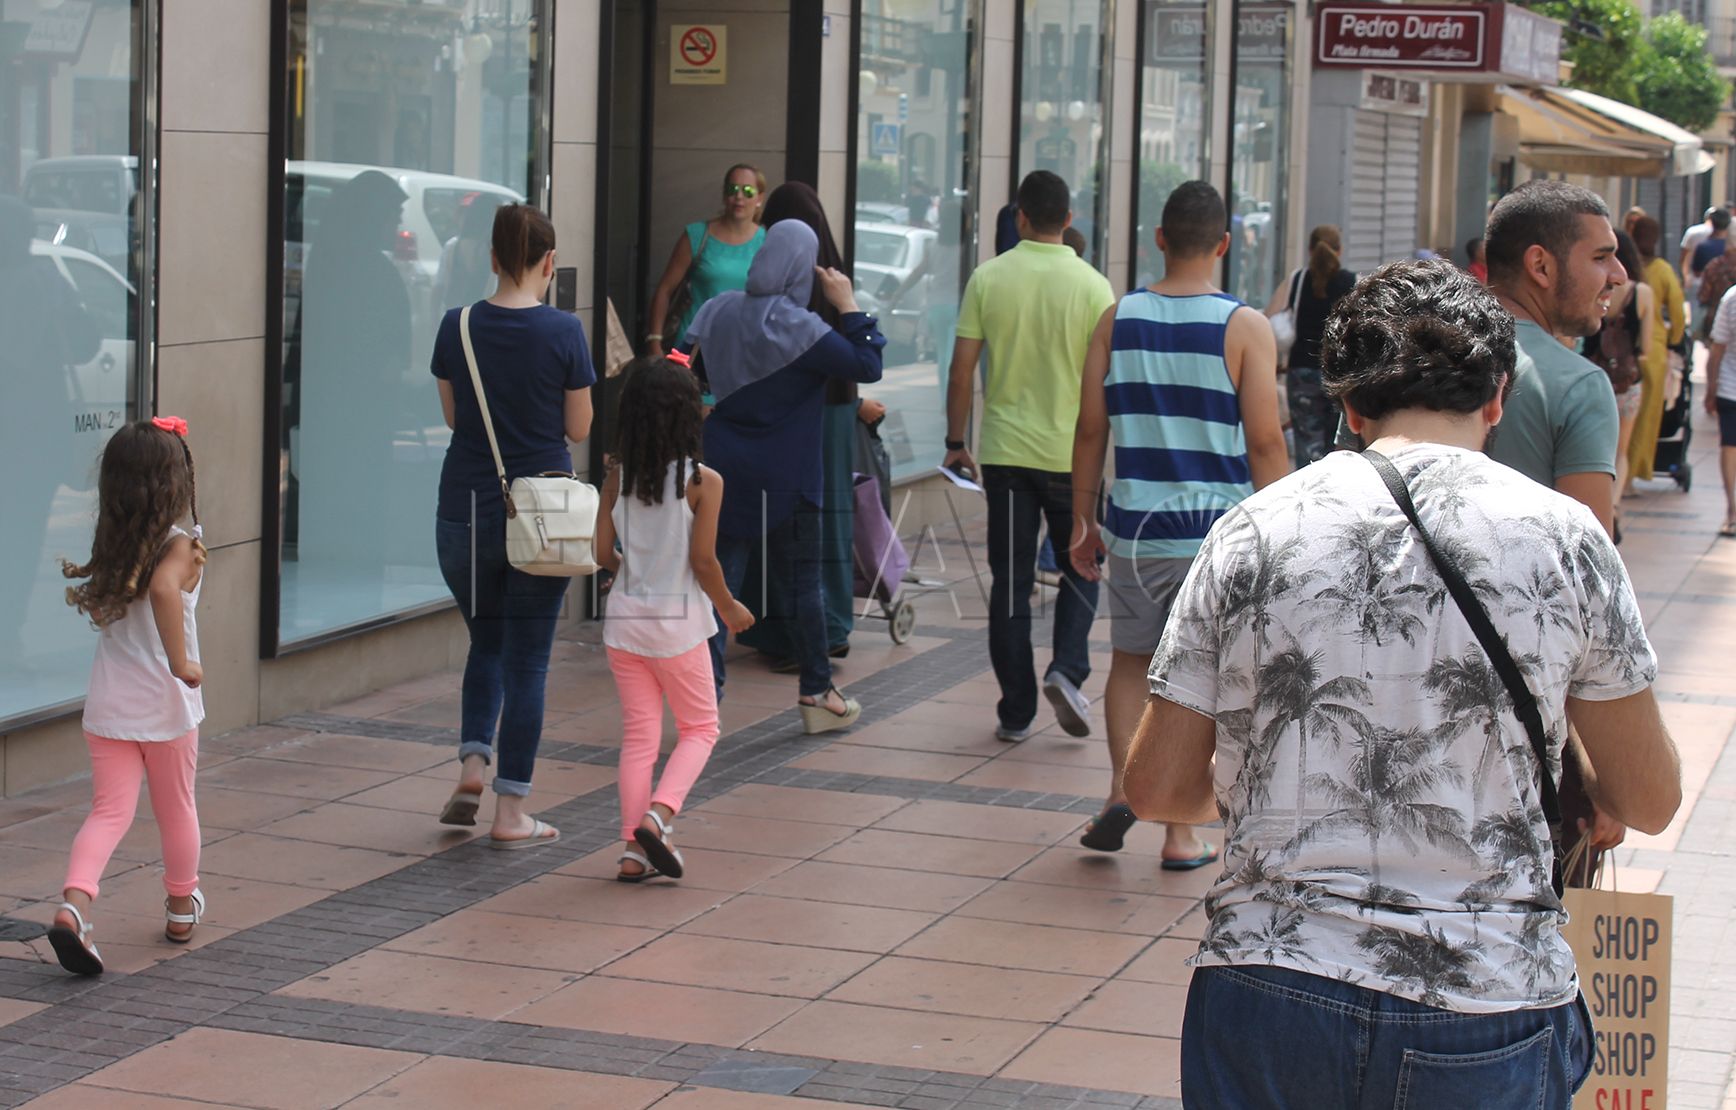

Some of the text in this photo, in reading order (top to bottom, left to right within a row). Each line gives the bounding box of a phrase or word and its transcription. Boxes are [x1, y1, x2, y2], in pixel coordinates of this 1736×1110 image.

[1339, 14, 1464, 40] Pedro Durán
[74, 412, 102, 433] MAN
[1593, 914, 1660, 961] SHOP
[1592, 971, 1658, 1019] SHOP
[1594, 1031, 1656, 1077] SHOP
